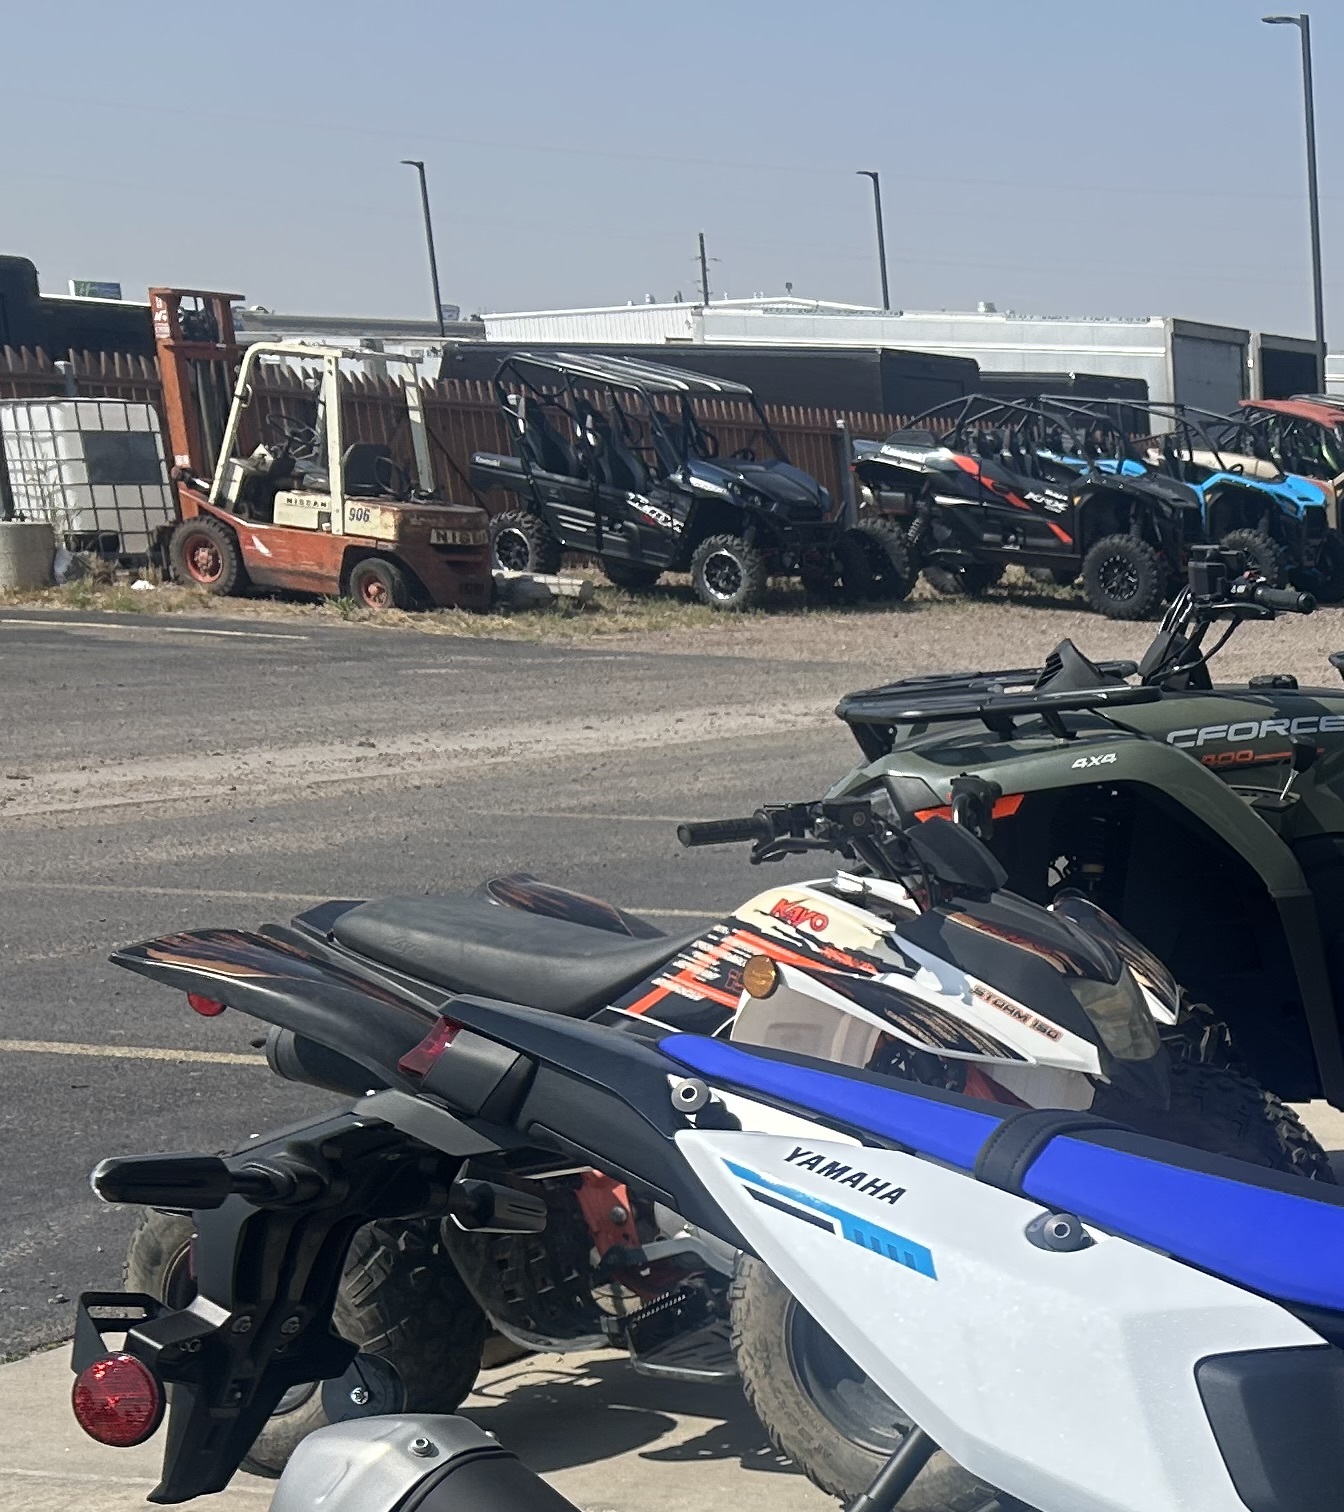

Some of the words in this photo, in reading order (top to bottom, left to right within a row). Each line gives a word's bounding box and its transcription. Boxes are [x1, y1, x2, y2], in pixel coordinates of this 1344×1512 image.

[348, 506, 371, 523] 906
[1070, 752, 1119, 769] 4X4
[1201, 749, 1254, 765] 400
[769, 897, 830, 933] KAYO
[783, 1146, 908, 1205] YAMAHA
